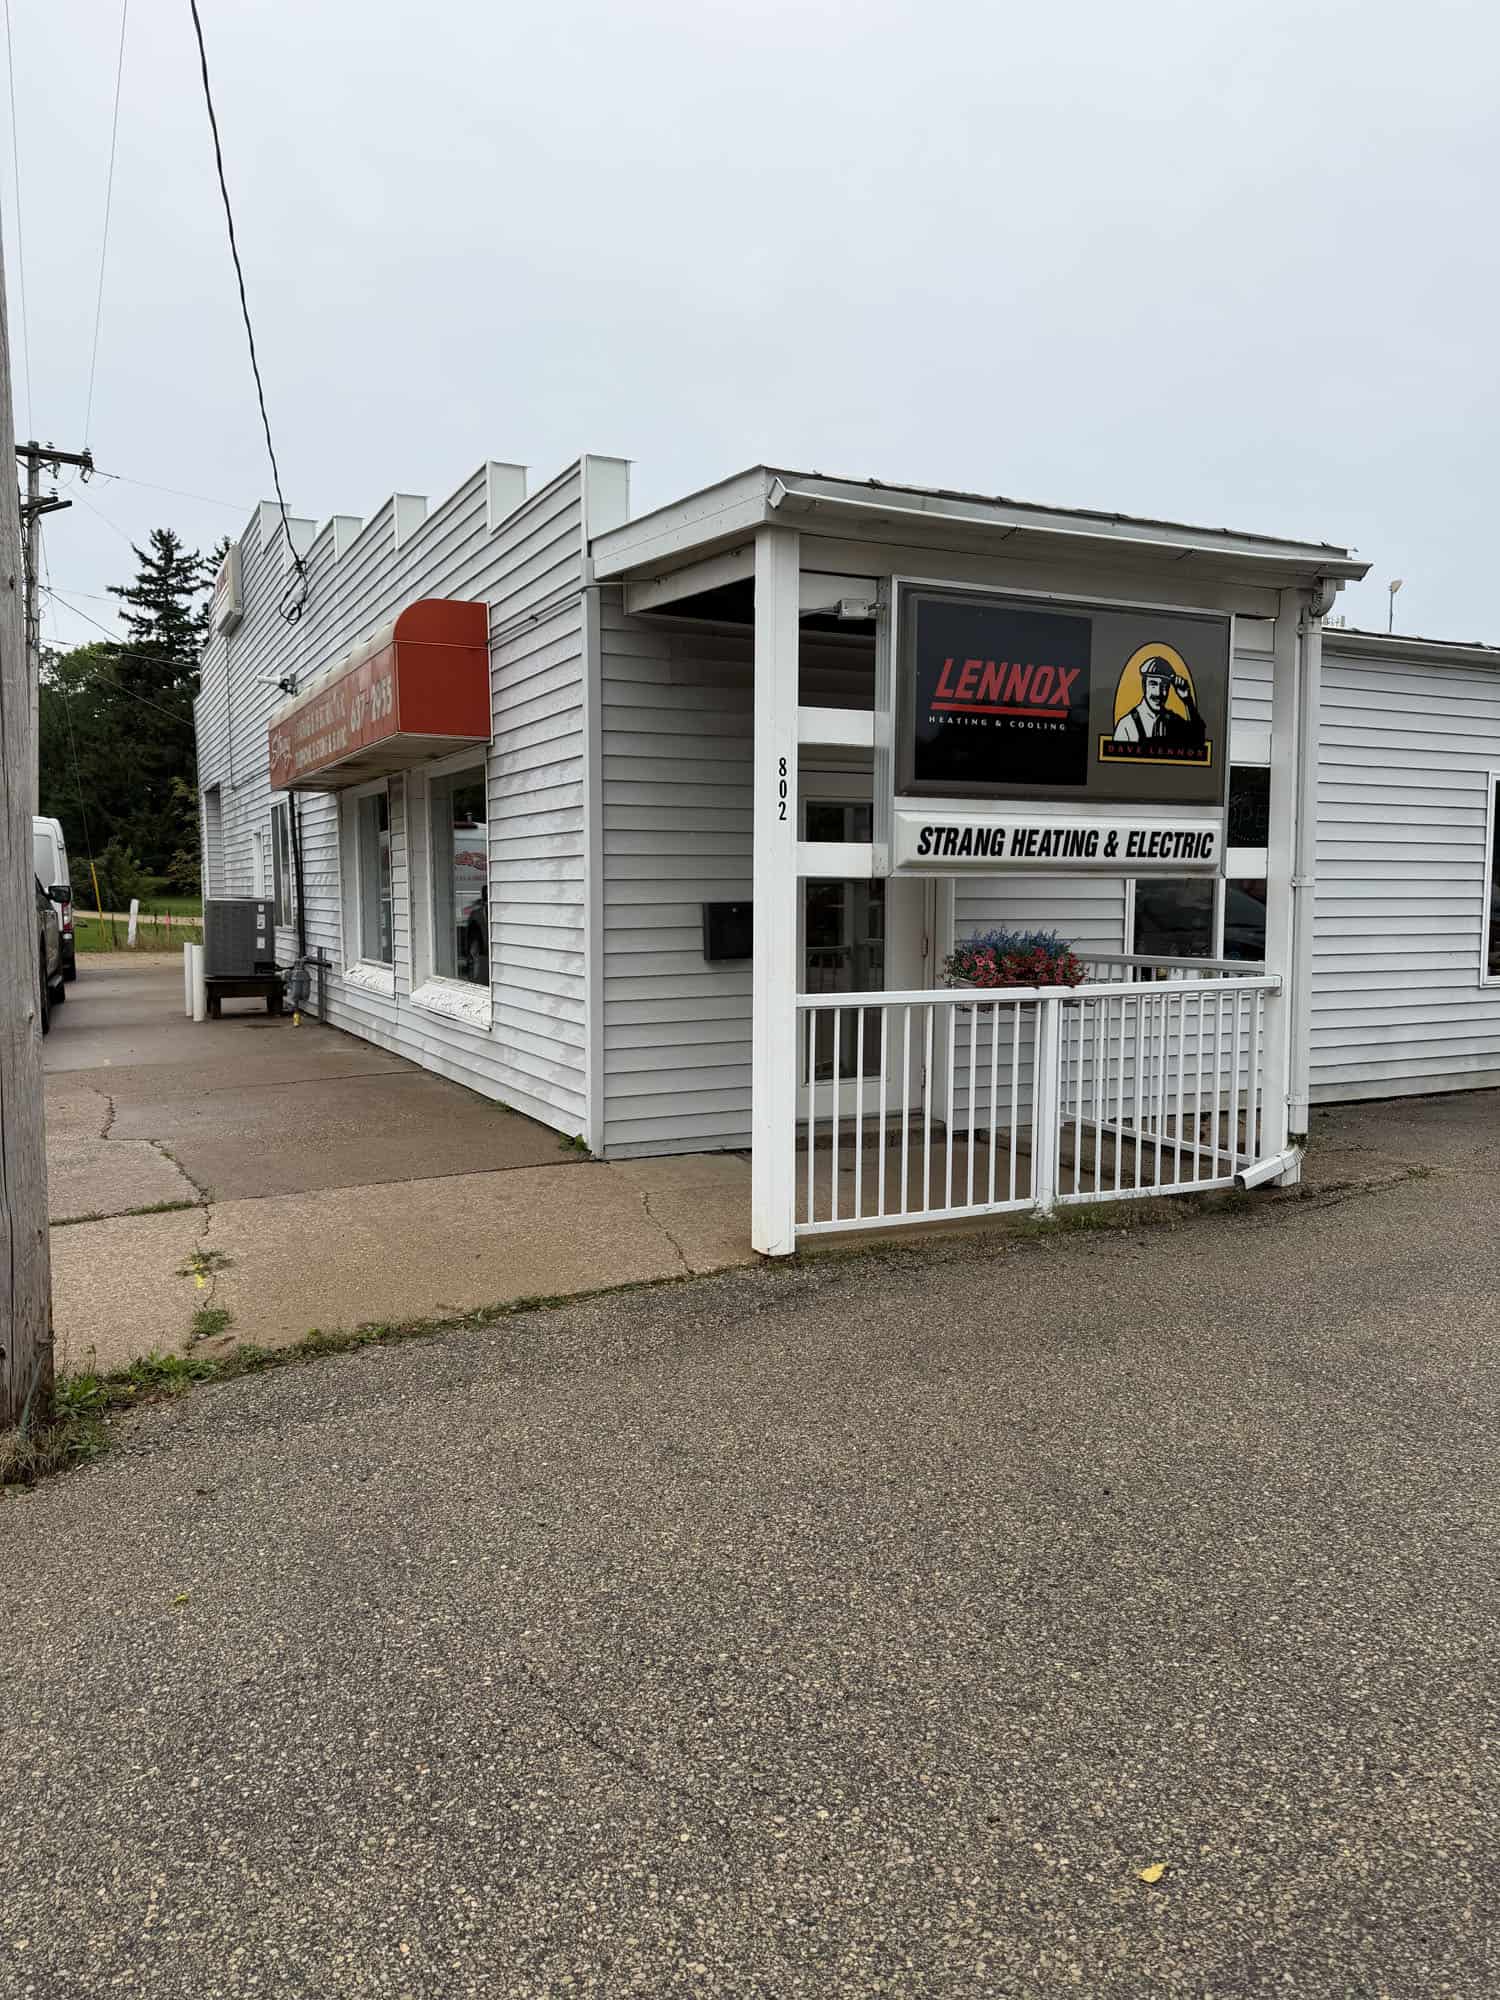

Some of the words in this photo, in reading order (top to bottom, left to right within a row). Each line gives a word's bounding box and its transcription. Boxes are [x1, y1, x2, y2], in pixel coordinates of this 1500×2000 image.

[934, 657, 1081, 706] LENNOX
[928, 715, 988, 727] HEATING
[995, 719, 1002, 728] &
[1009, 720, 1066, 731] COOLING
[1107, 744, 1142, 754] DAVE
[1148, 746, 1203, 757] LENNOX
[778, 757, 788, 821] 802
[917, 826, 1006, 857] STRANG
[1011, 828, 1098, 858] HEATING
[1103, 830, 1120, 858] &
[1126, 830, 1214, 860] ELECTRIC
